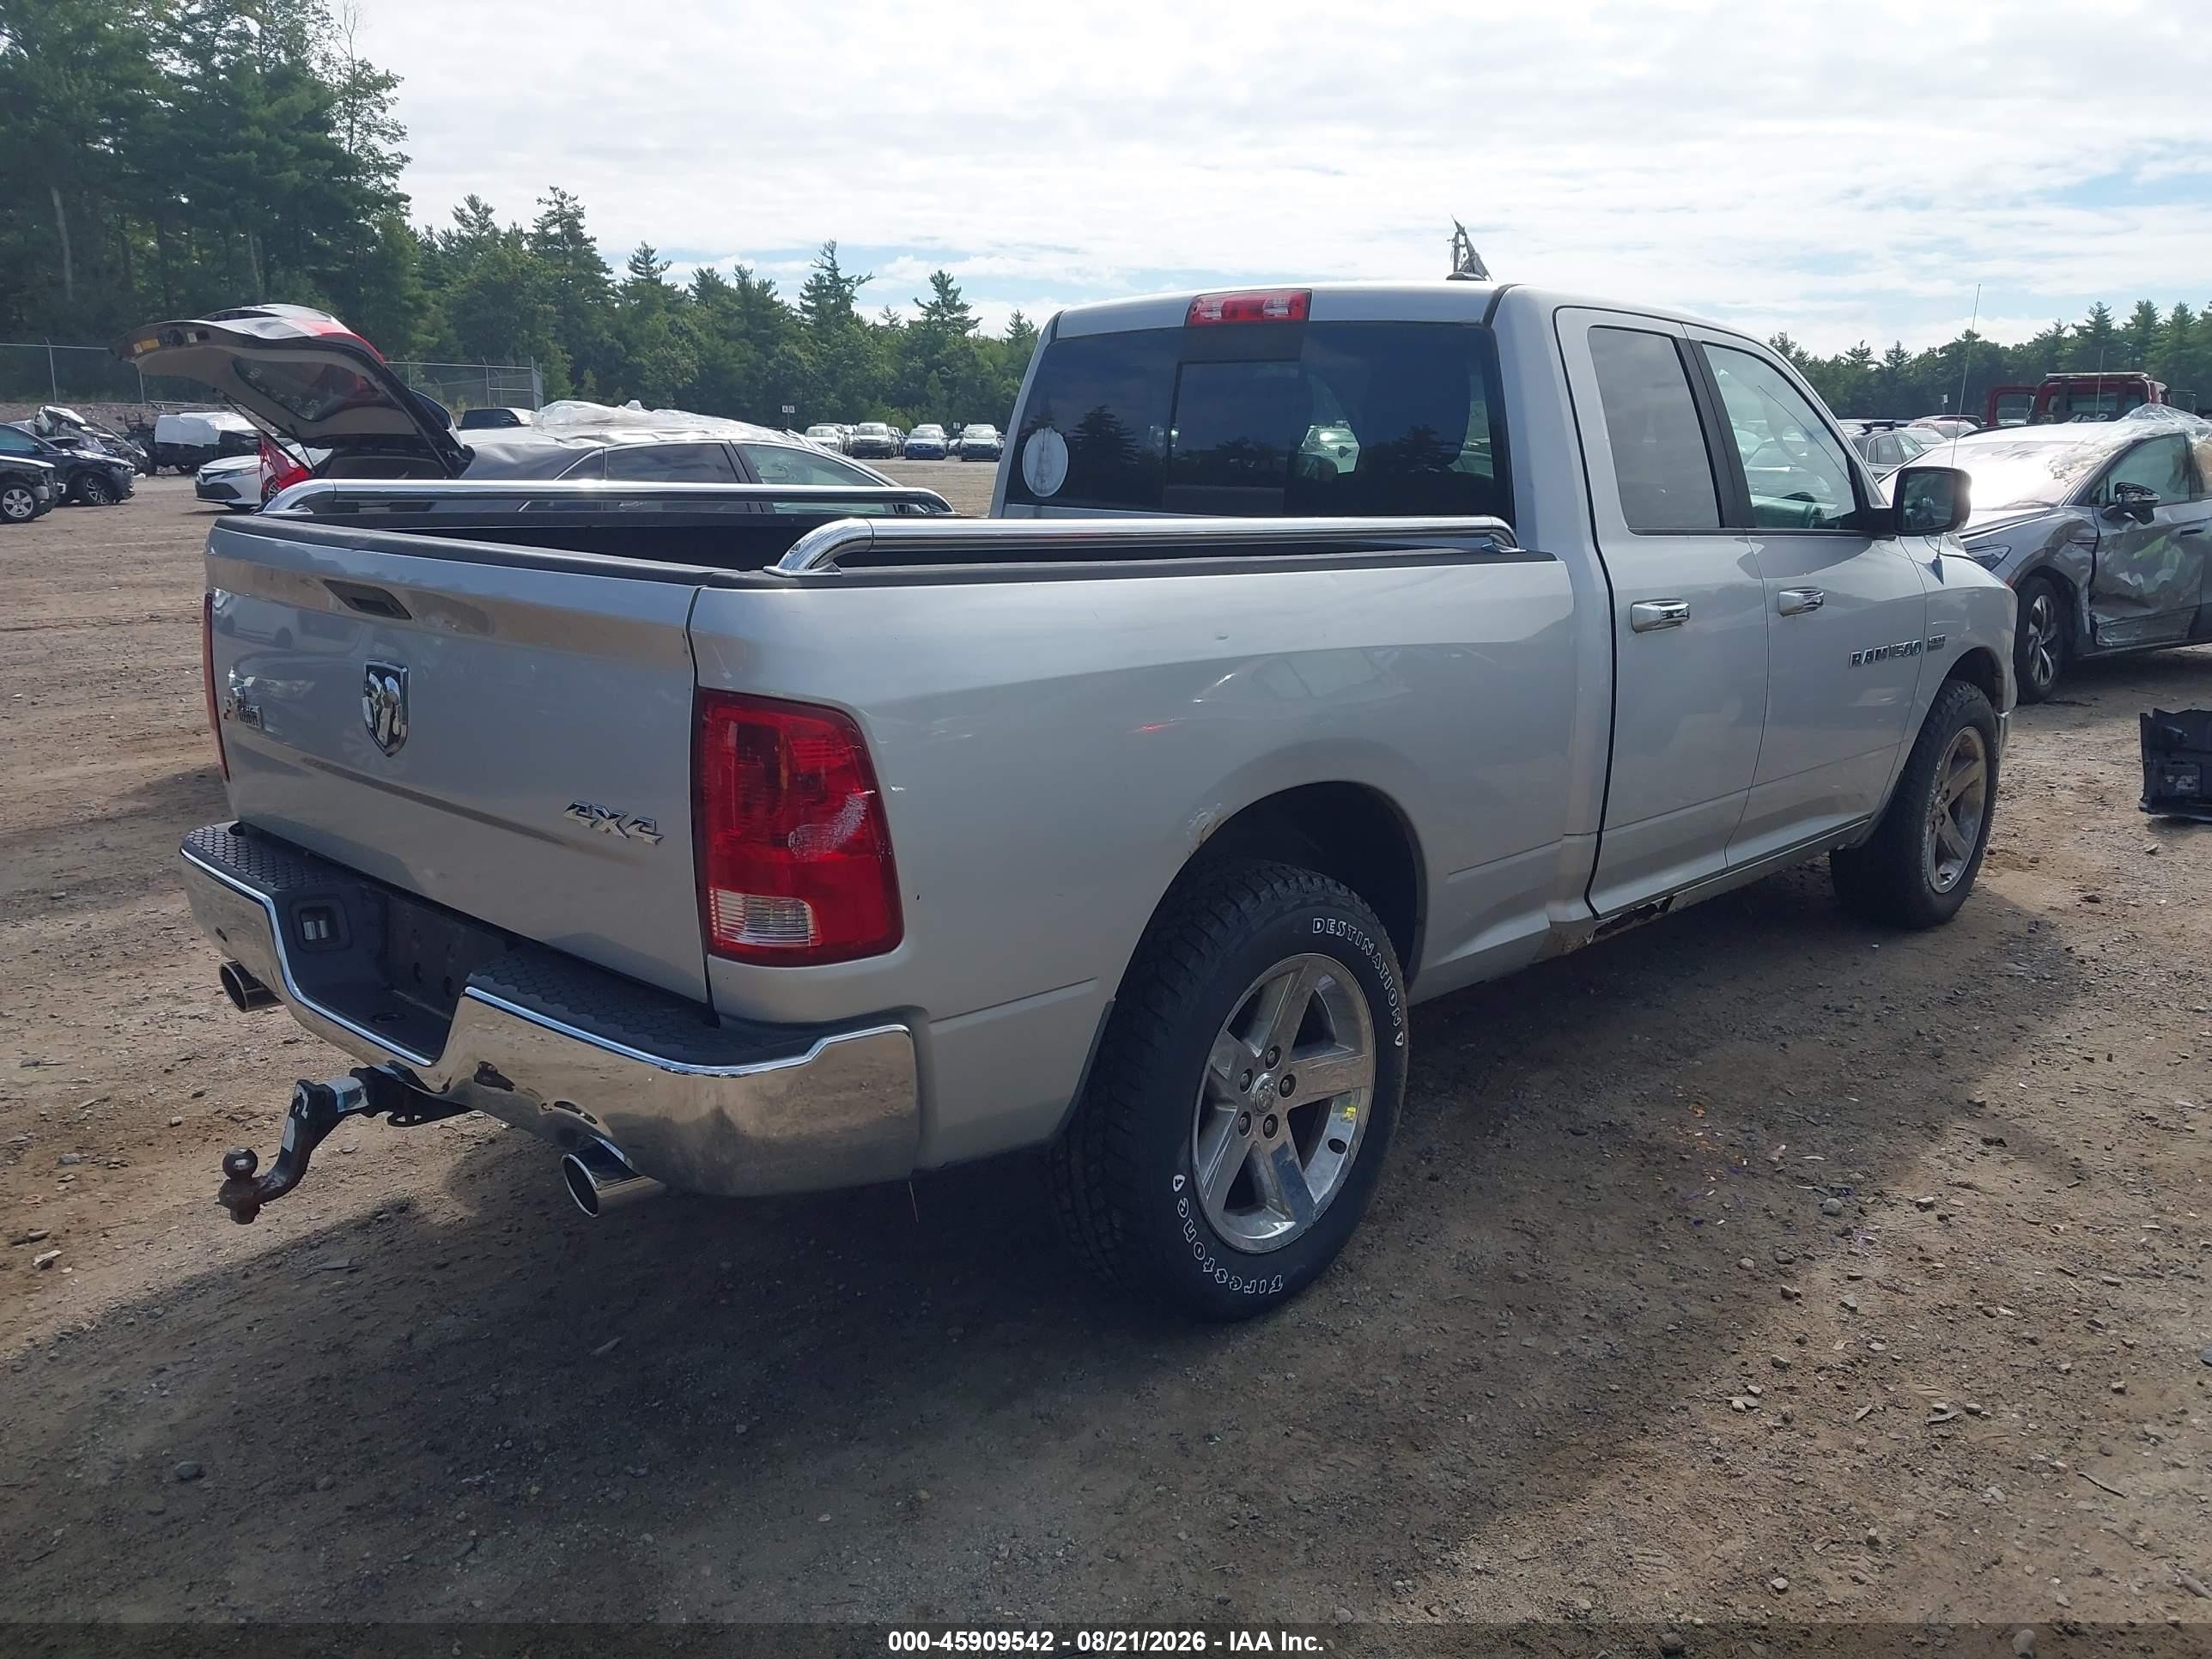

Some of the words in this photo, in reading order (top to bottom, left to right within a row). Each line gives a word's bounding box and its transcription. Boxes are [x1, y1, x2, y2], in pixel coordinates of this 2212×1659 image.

[1849, 644, 1888, 667] RAM
[1889, 639, 1923, 659] 1500
[1312, 917, 1402, 1027] DESTINATION
